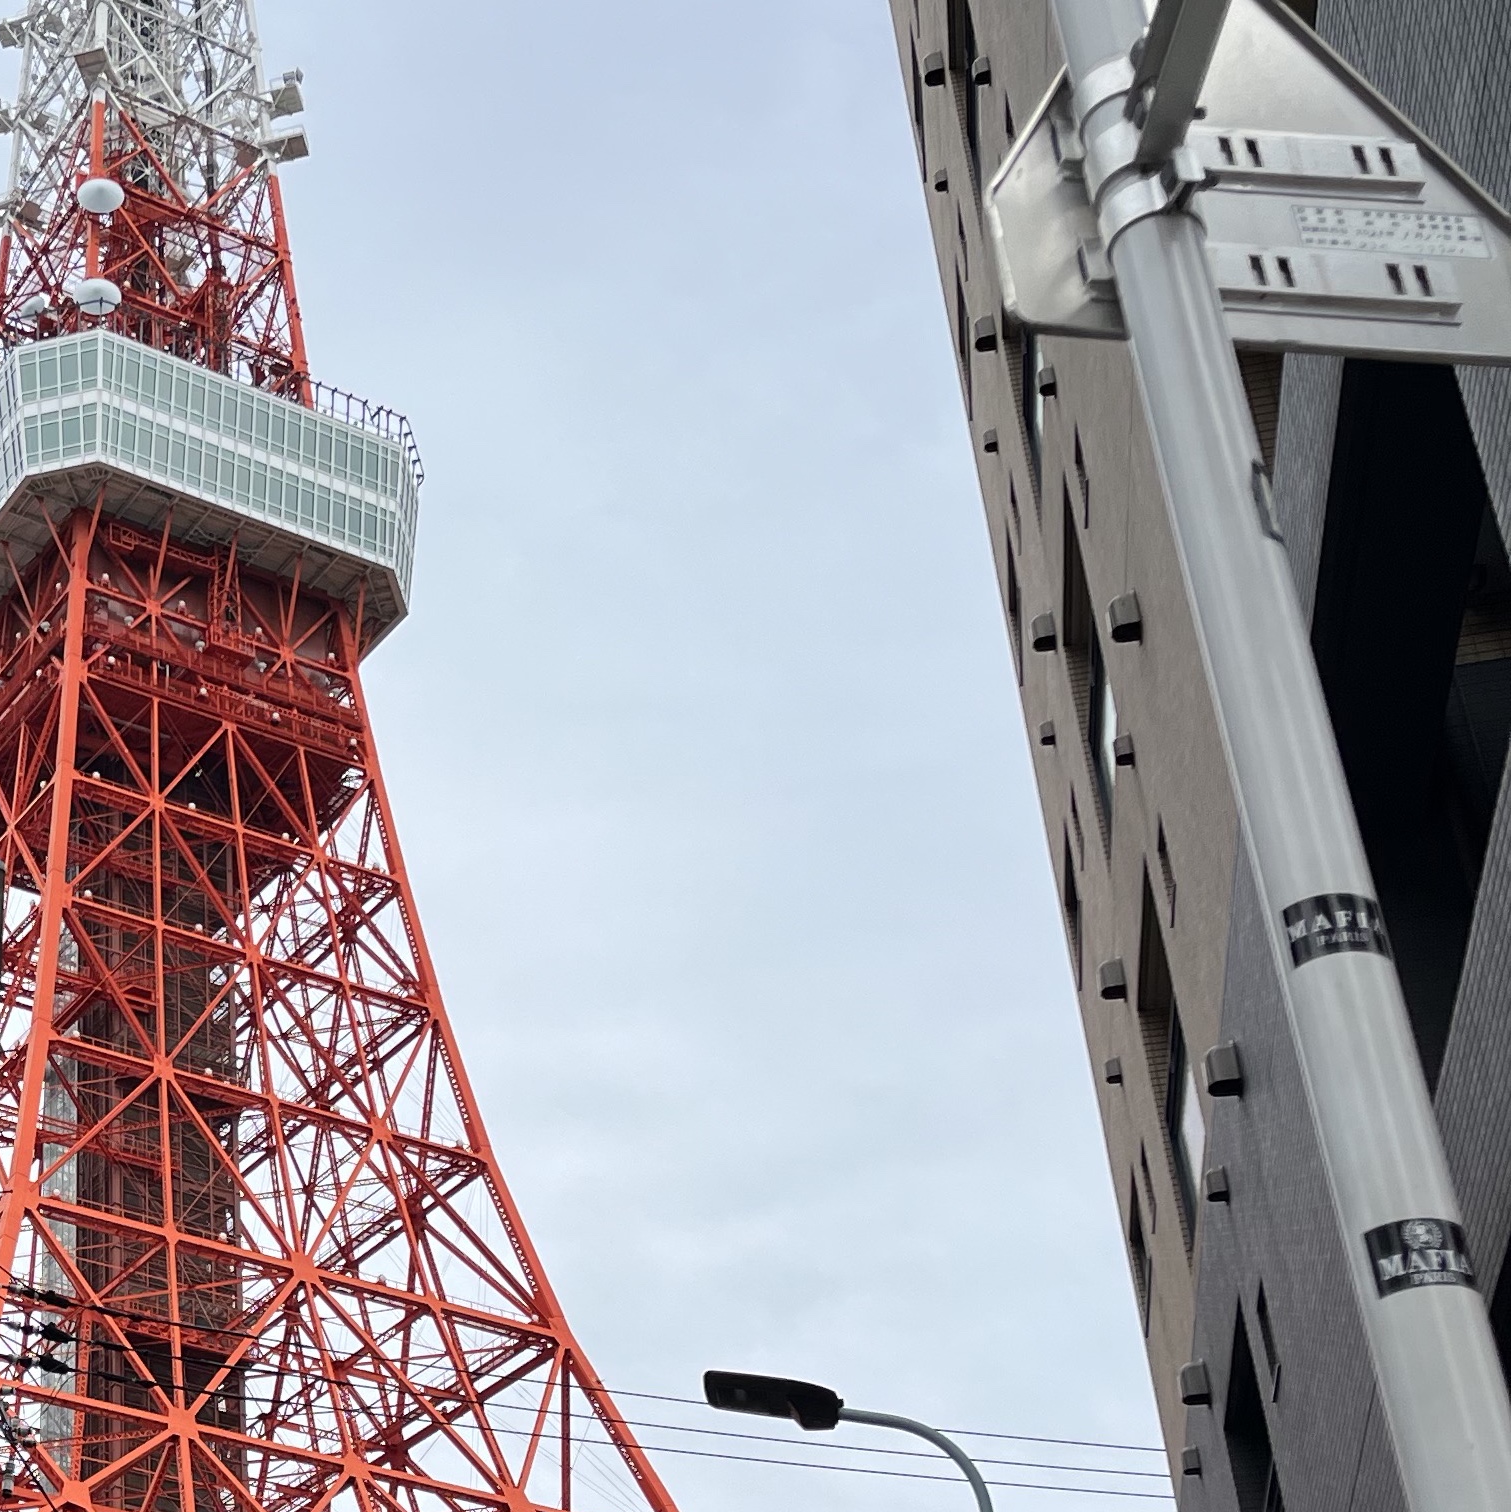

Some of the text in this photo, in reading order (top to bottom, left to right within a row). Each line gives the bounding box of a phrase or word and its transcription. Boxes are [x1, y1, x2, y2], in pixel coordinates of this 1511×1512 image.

[1287, 910, 1384, 942] MAFIA
[1377, 1248, 1472, 1281] MAFIA
[1411, 1271, 1457, 1285] PARIS
